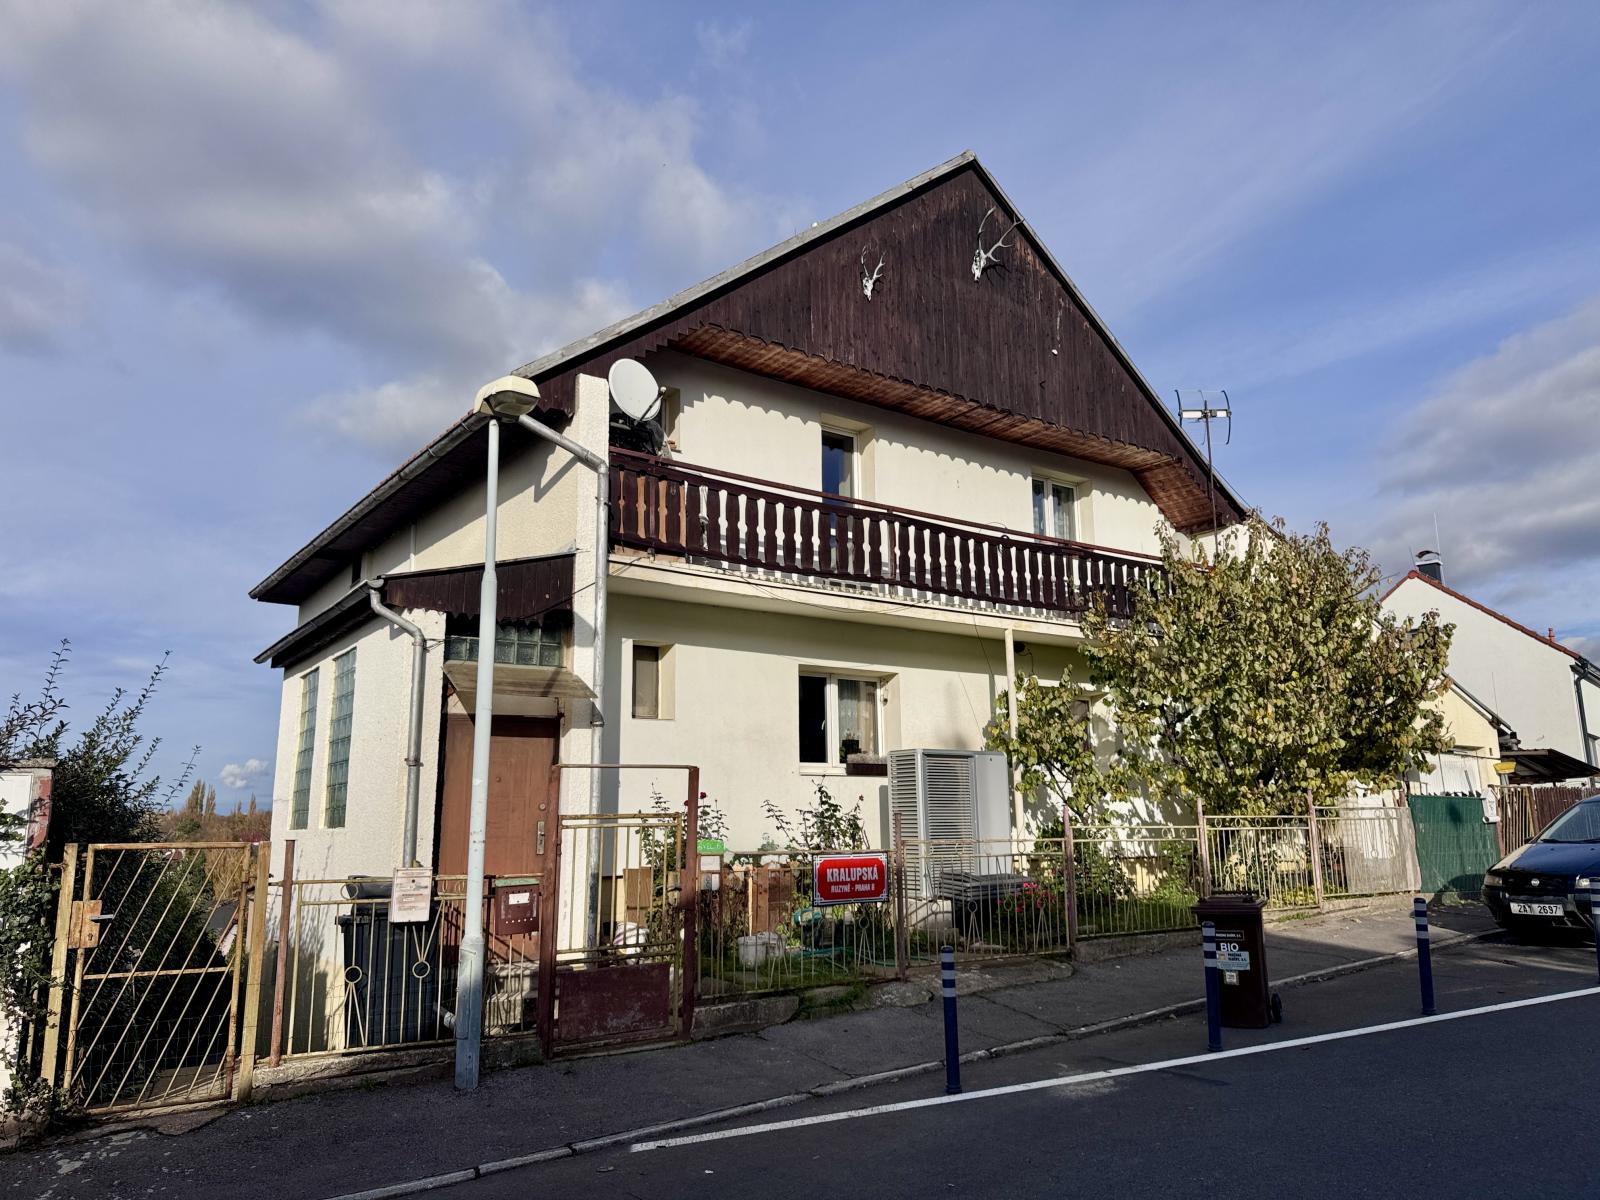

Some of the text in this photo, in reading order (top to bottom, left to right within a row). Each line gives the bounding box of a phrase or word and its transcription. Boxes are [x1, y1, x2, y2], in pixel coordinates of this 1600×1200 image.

[826, 864, 879, 882] KRALUPSKÁ
[1537, 905, 1558, 915] 2697
[1220, 942, 1239, 952] BIO
